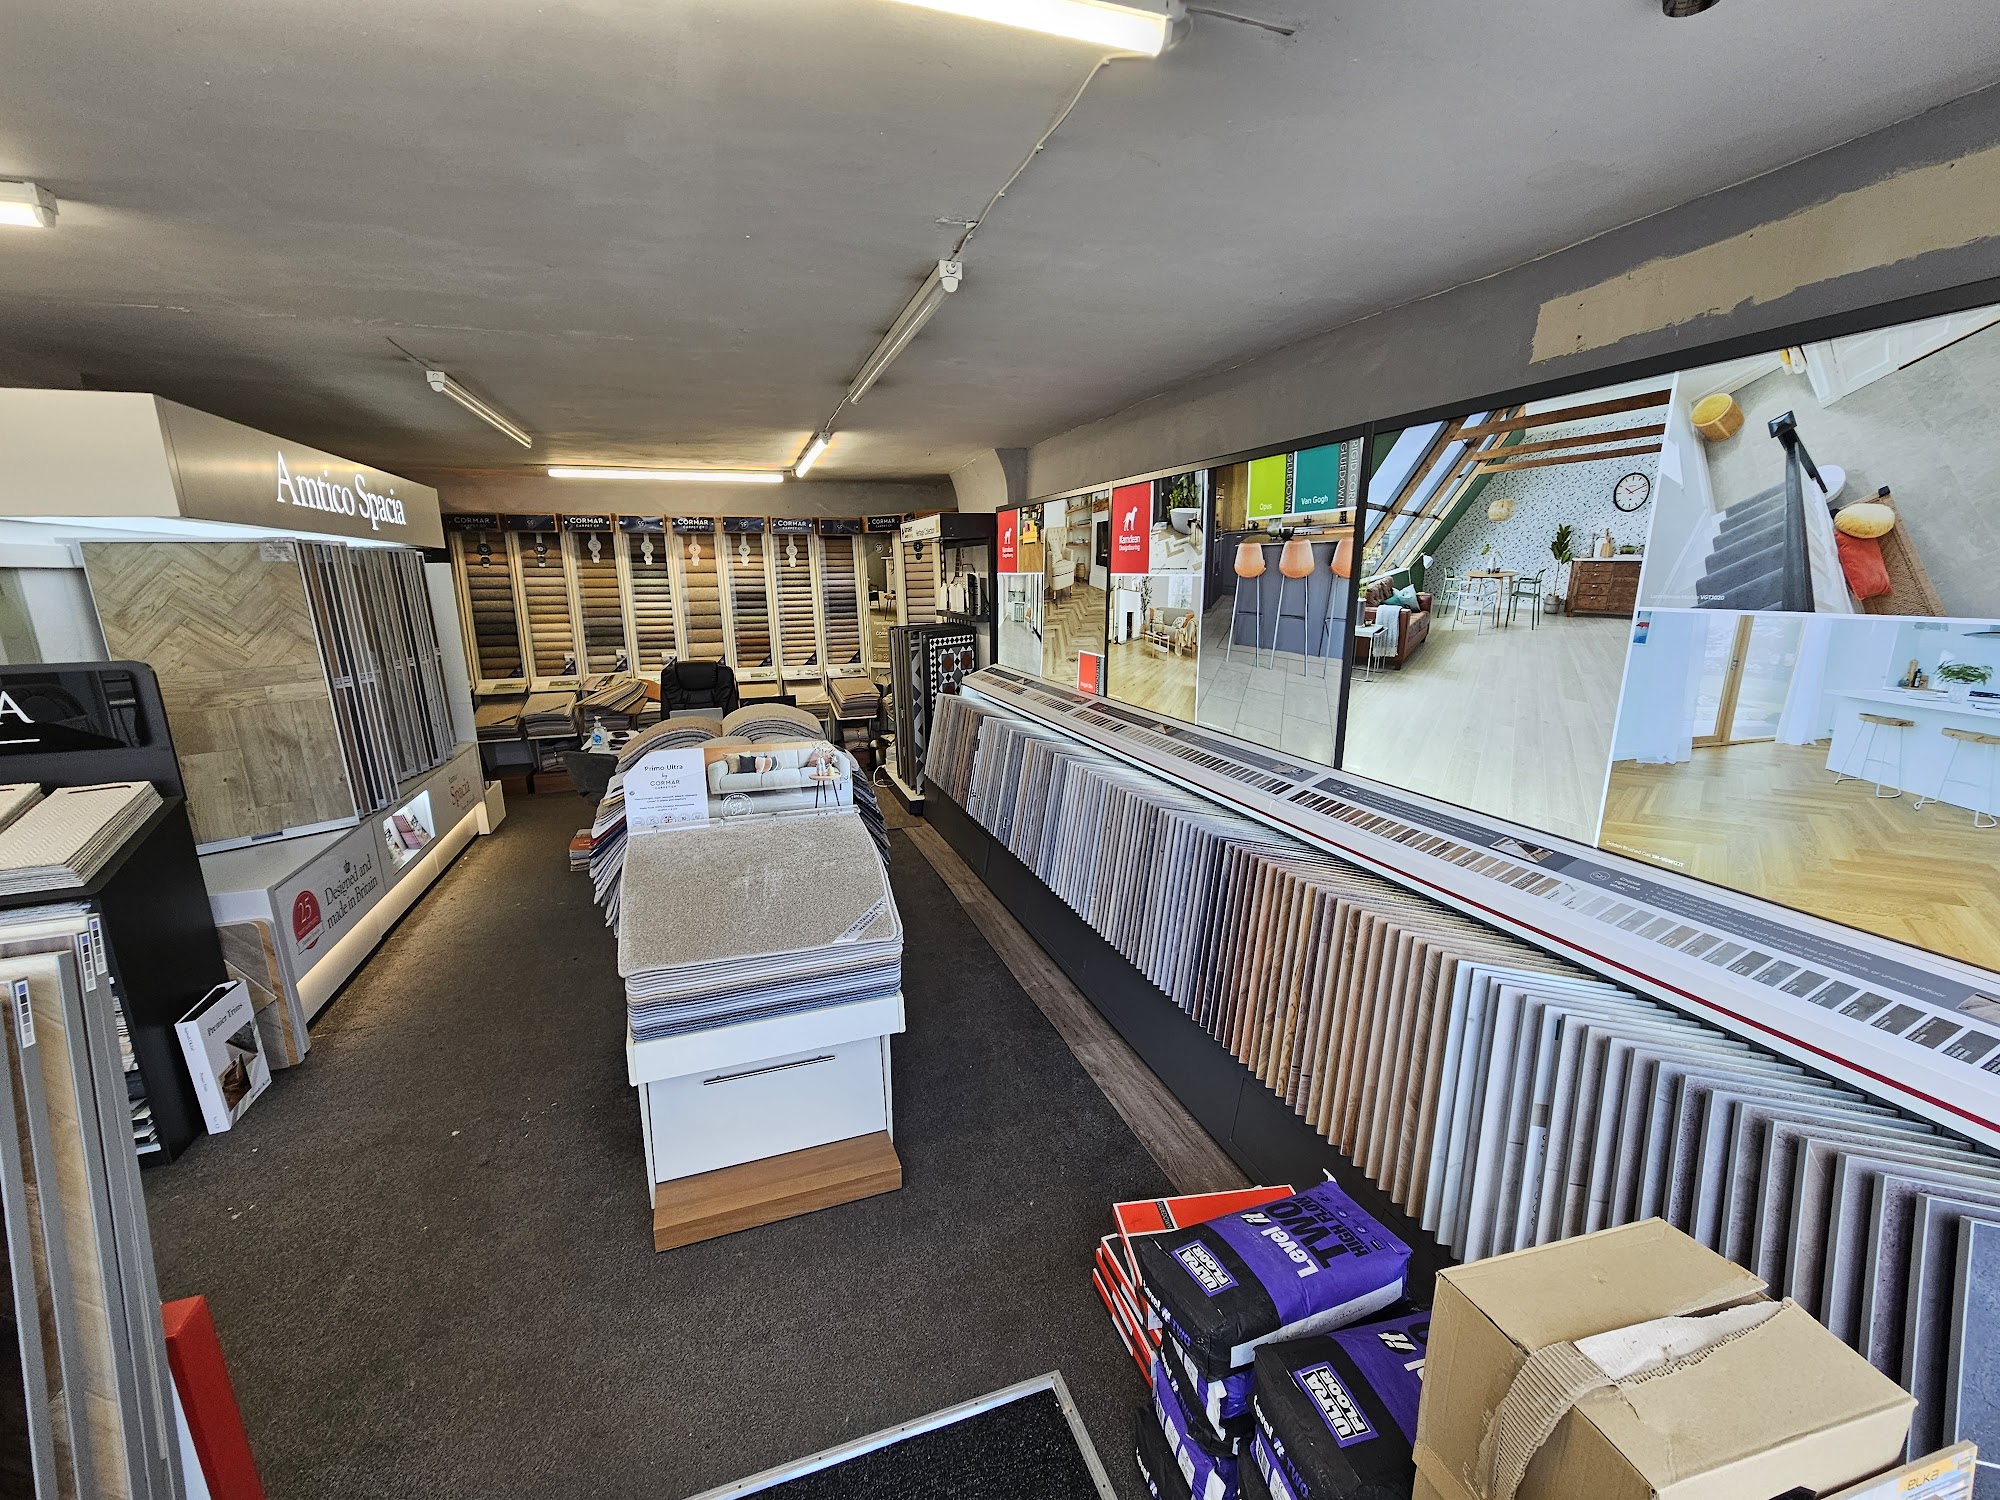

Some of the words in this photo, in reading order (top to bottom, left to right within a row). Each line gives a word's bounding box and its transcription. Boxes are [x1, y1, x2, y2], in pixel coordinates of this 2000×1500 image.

[1351, 440, 1359, 471] RIGID
[277, 451, 355, 516] Amtico
[355, 473, 407, 530] Spacia
[1285, 453, 1293, 512] GLUEDOWN
[1338, 442, 1347, 506] GLUEDOWN
[1349, 475, 1357, 504] CORE
[1260, 503, 1272, 511] Opus
[1301, 497, 1311, 505] Van
[1313, 495, 1328, 504] Gogh
[453, 516, 490, 524] CORMAR
[677, 518, 709, 526] CORMAR
[777, 519, 807, 527] CORMAR
[871, 517, 895, 525] CORMAR
[324, 869, 358, 906] Designed
[358, 854, 372, 875] and
[298, 898, 311, 923] 25
[327, 899, 348, 929] made
[347, 897, 356, 911] in
[355, 875, 378, 903] Britain
[207, 1017, 227, 1036] Premier
[228, 1003, 243, 1018] Trims
[1293, 1195, 1335, 1224] FLOW
[1260, 1226, 1319, 1278] Level
[1265, 1201, 1351, 1270] TWO
[1328, 1224, 1370, 1258] HIGH
[1181, 1249, 1218, 1290] ULTRA
[1192, 1246, 1229, 1284] FLOOR
[1306, 1373, 1352, 1439] ULTRA
[1319, 1370, 1366, 1431] FLOOR
[1286, 1457, 1309, 1499] TWO
